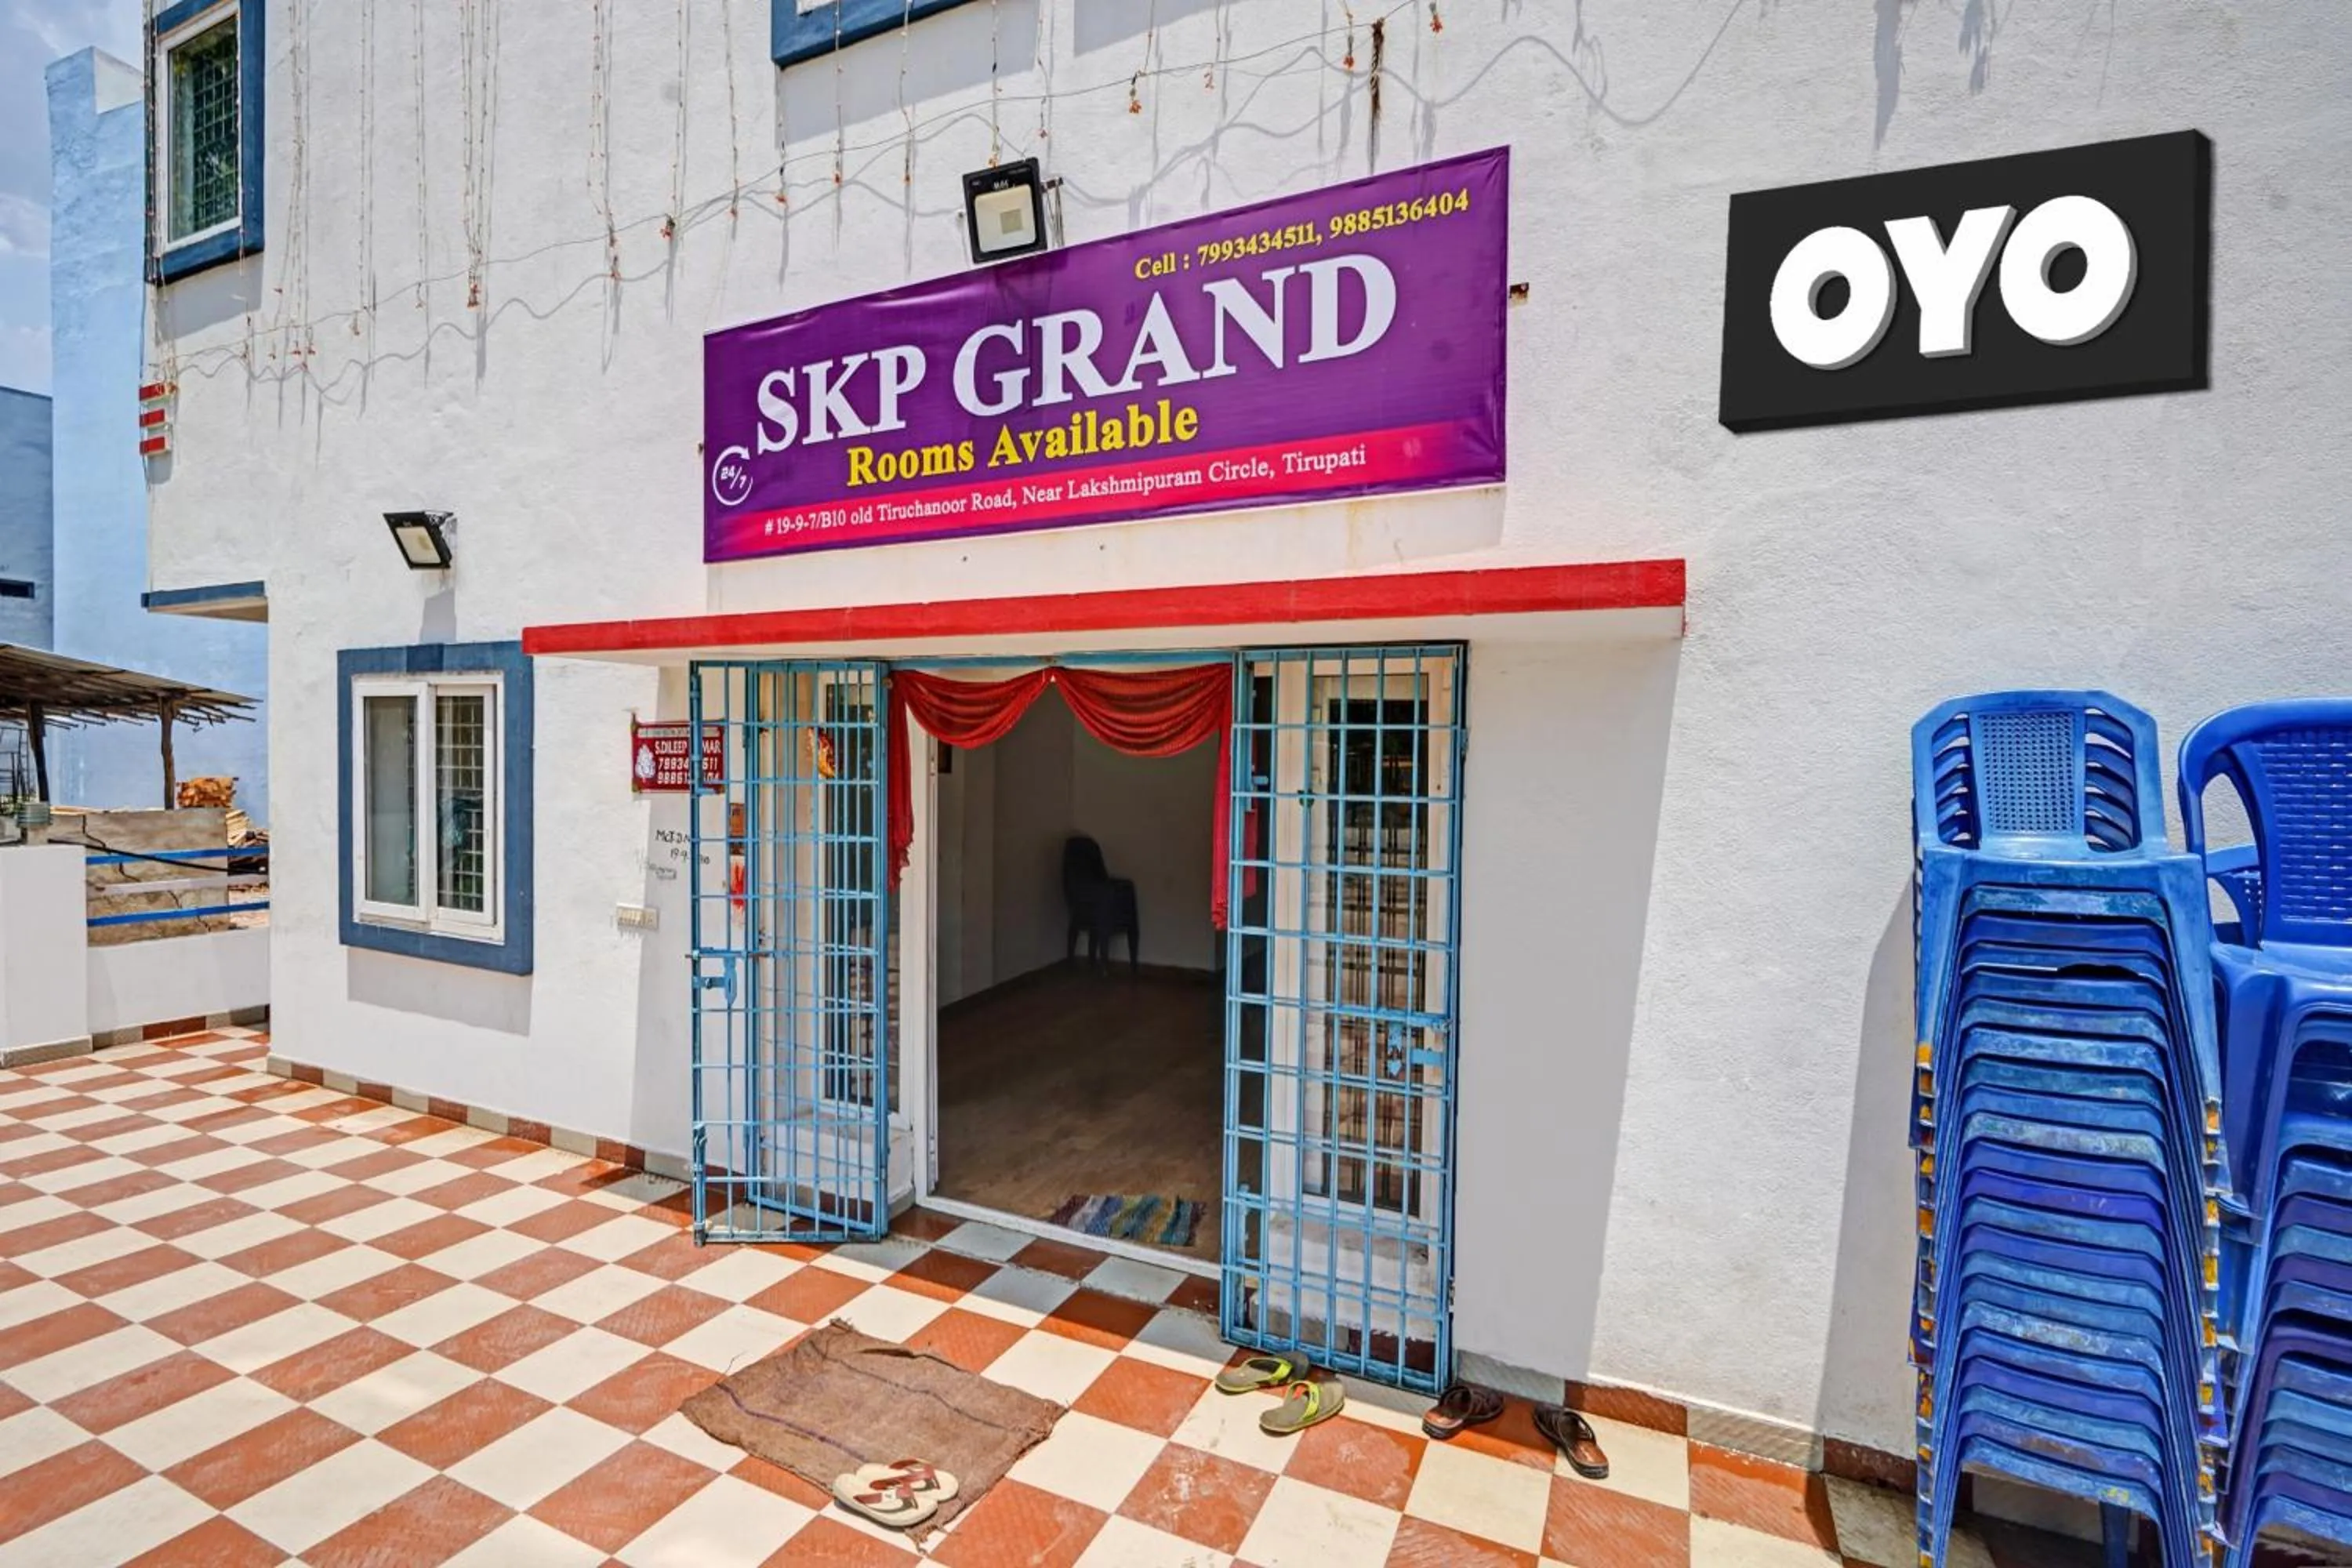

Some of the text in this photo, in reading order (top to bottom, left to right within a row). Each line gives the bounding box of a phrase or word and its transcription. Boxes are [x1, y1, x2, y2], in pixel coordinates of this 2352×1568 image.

[1134, 252, 1177, 280] Cell
[1196, 223, 1323, 262] 7993434511,
[1329, 188, 1470, 238] 9885136404
[1769, 194, 2139, 372] OYO
[757, 254, 1397, 456] SKP GRAND
[846, 398, 1199, 488] Rooms Available
[850, 505, 873, 525] old
[876, 497, 967, 522] Tiruchanoor
[971, 488, 1018, 511] Road,
[1022, 484, 1063, 506] Near
[1067, 470, 1203, 501] Lakshmipuram
[1208, 457, 1275, 483] Circle,
[1282, 444, 1367, 475] Tirupati
